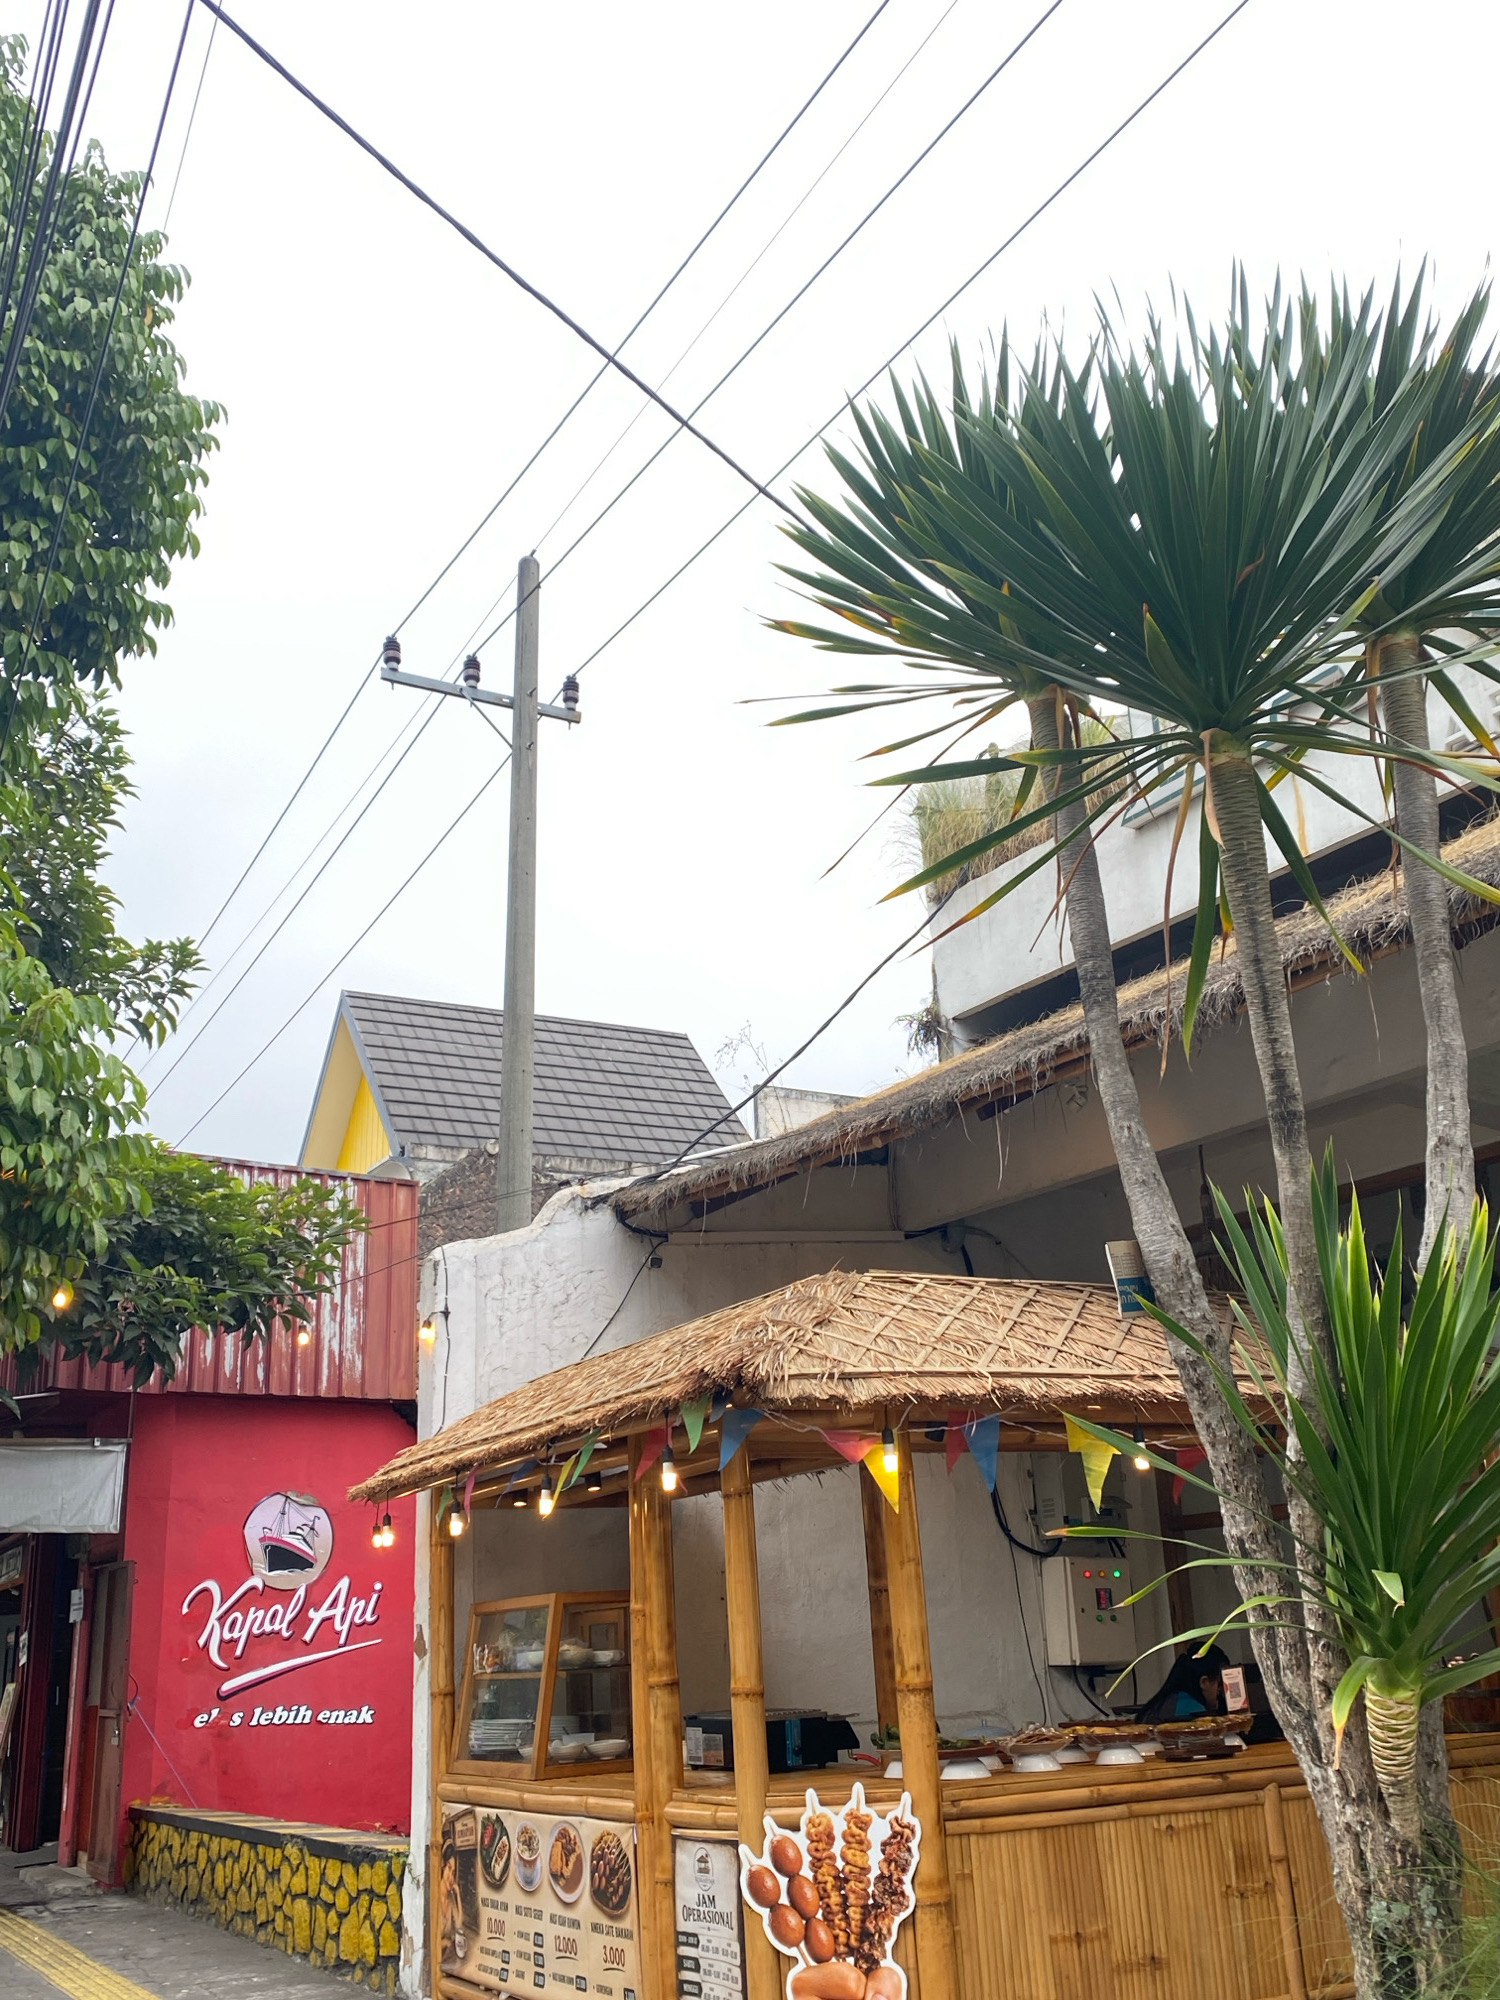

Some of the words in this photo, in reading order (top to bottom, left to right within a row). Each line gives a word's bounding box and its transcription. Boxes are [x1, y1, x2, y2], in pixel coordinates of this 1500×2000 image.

[181, 1575, 307, 1671] Kapal
[300, 1575, 384, 1646] Api
[249, 1704, 314, 1727] lebih
[317, 1704, 376, 1725] enak
[695, 1894, 716, 1909] JAM
[487, 1917, 506, 1937] 10.000
[682, 1904, 734, 1931] OPERASIONAL
[554, 1934, 578, 1956] 12.000
[602, 1945, 626, 1967] 3.000
